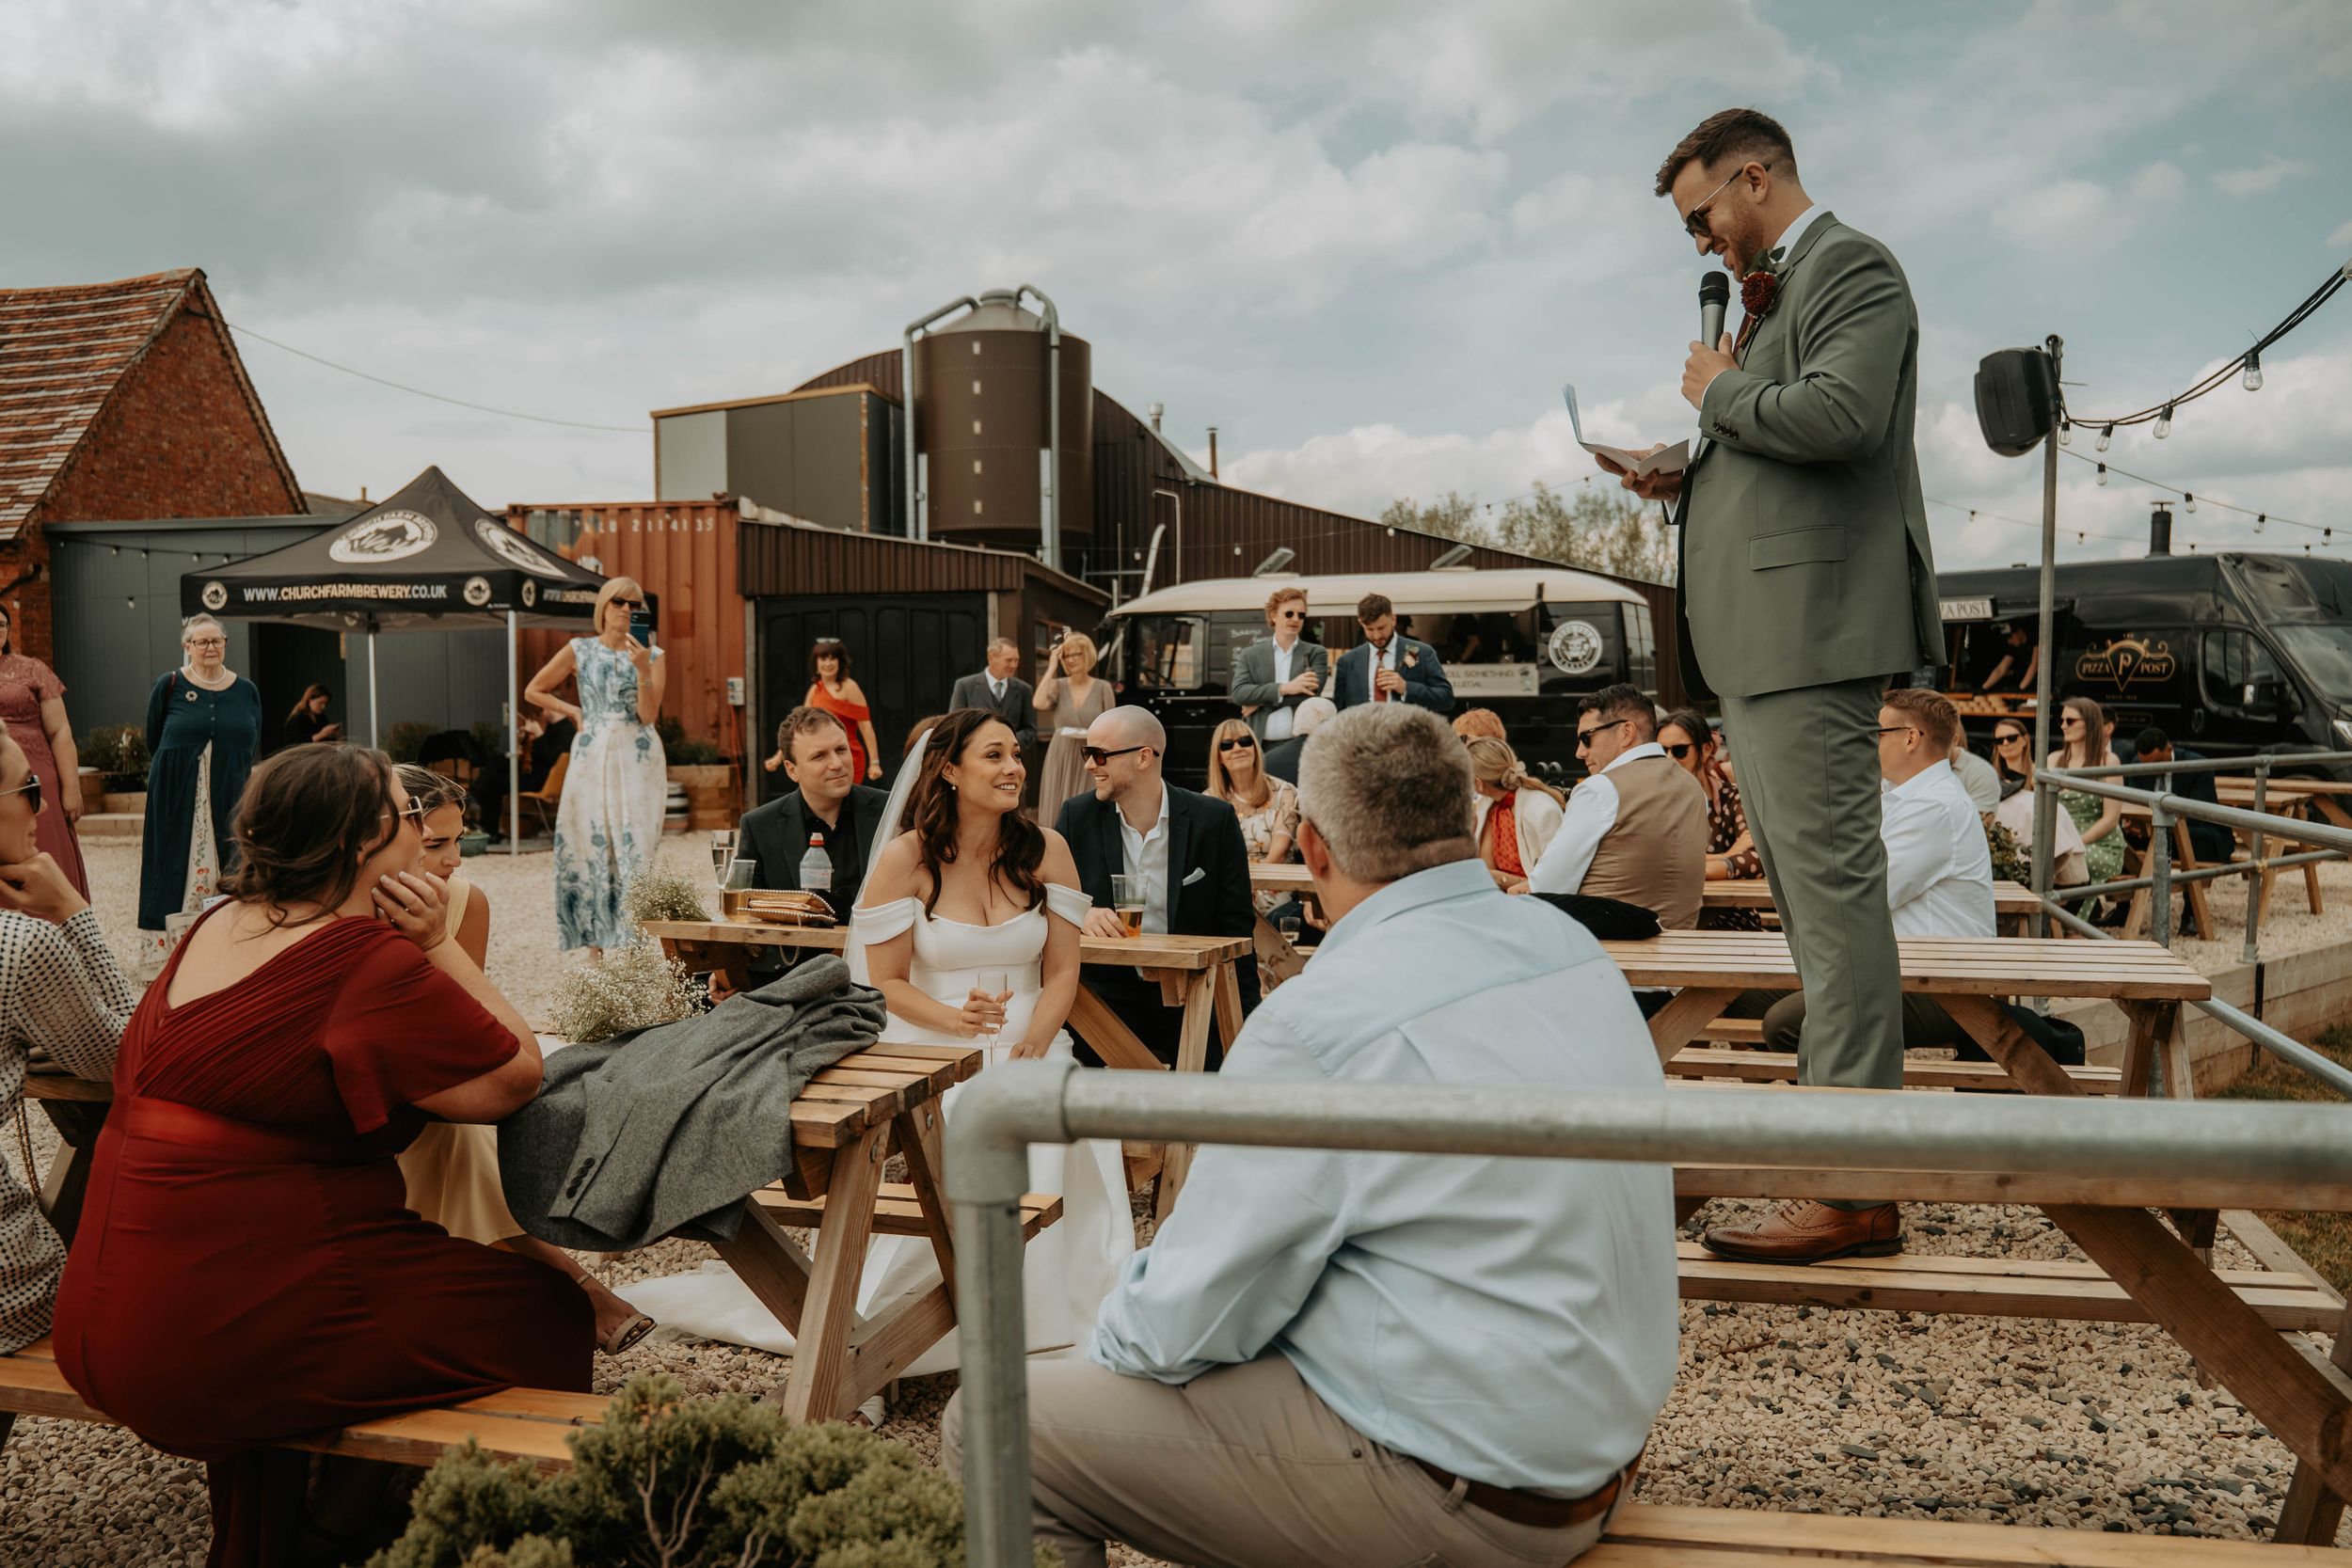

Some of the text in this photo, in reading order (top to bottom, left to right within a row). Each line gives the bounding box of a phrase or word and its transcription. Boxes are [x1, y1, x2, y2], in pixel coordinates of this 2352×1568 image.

[244, 583, 448, 602] WWW.CHURCHFARMBREWERY.CO.UK
[1957, 601, 1987, 617] POST
[2082, 661, 2169, 674] PIZZA POST
